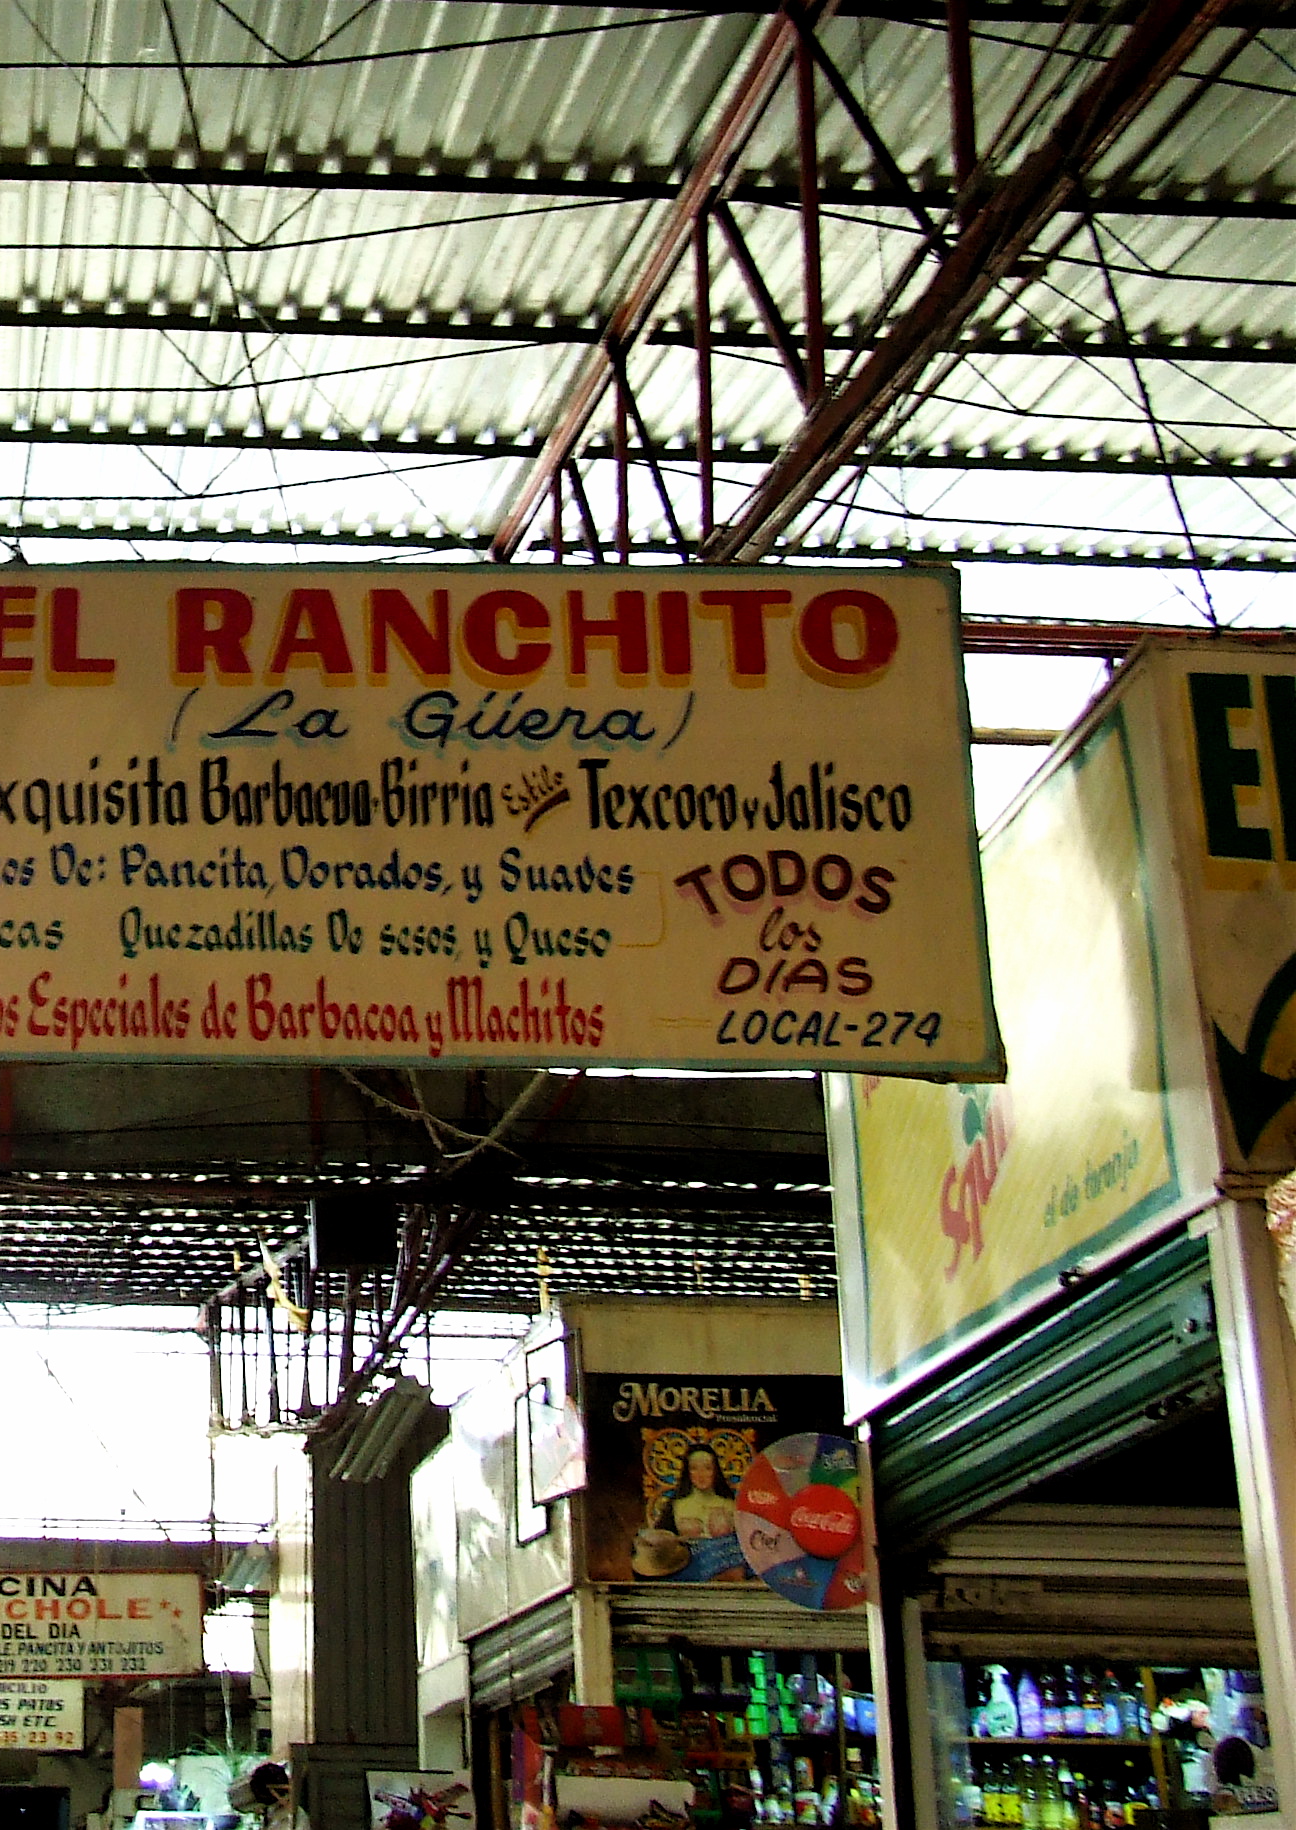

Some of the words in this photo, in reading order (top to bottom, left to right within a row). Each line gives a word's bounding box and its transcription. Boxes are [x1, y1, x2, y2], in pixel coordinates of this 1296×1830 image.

[172, 586, 899, 686] RANCHITO
[501, 764, 564, 815] Estilo
[578, 758, 737, 831] Texcoco
[763, 760, 912, 832] Jalisco
[461, 864, 483, 903] y
[498, 847, 634, 896] Suaves
[673, 848, 897, 917] TODOS
[118, 905, 315, 958] Quezadillas
[327, 908, 364, 954] De
[474, 927, 493, 968] y
[504, 911, 612, 965] Queso
[758, 906, 822, 952] los
[716, 956, 874, 997] DIAS
[27, 970, 190, 1050] Especiales
[201, 980, 237, 1040] de
[245, 971, 419, 1043] Barbacoa
[424, 1009, 444, 1058] y
[446, 975, 606, 1048] Machitos
[716, 1009, 943, 1048] LOCAL-274
[0, 1623, 38, 1641] DEL
[48, 1623, 82, 1640] DIA
[4, 1597, 154, 1622] CHOLE
